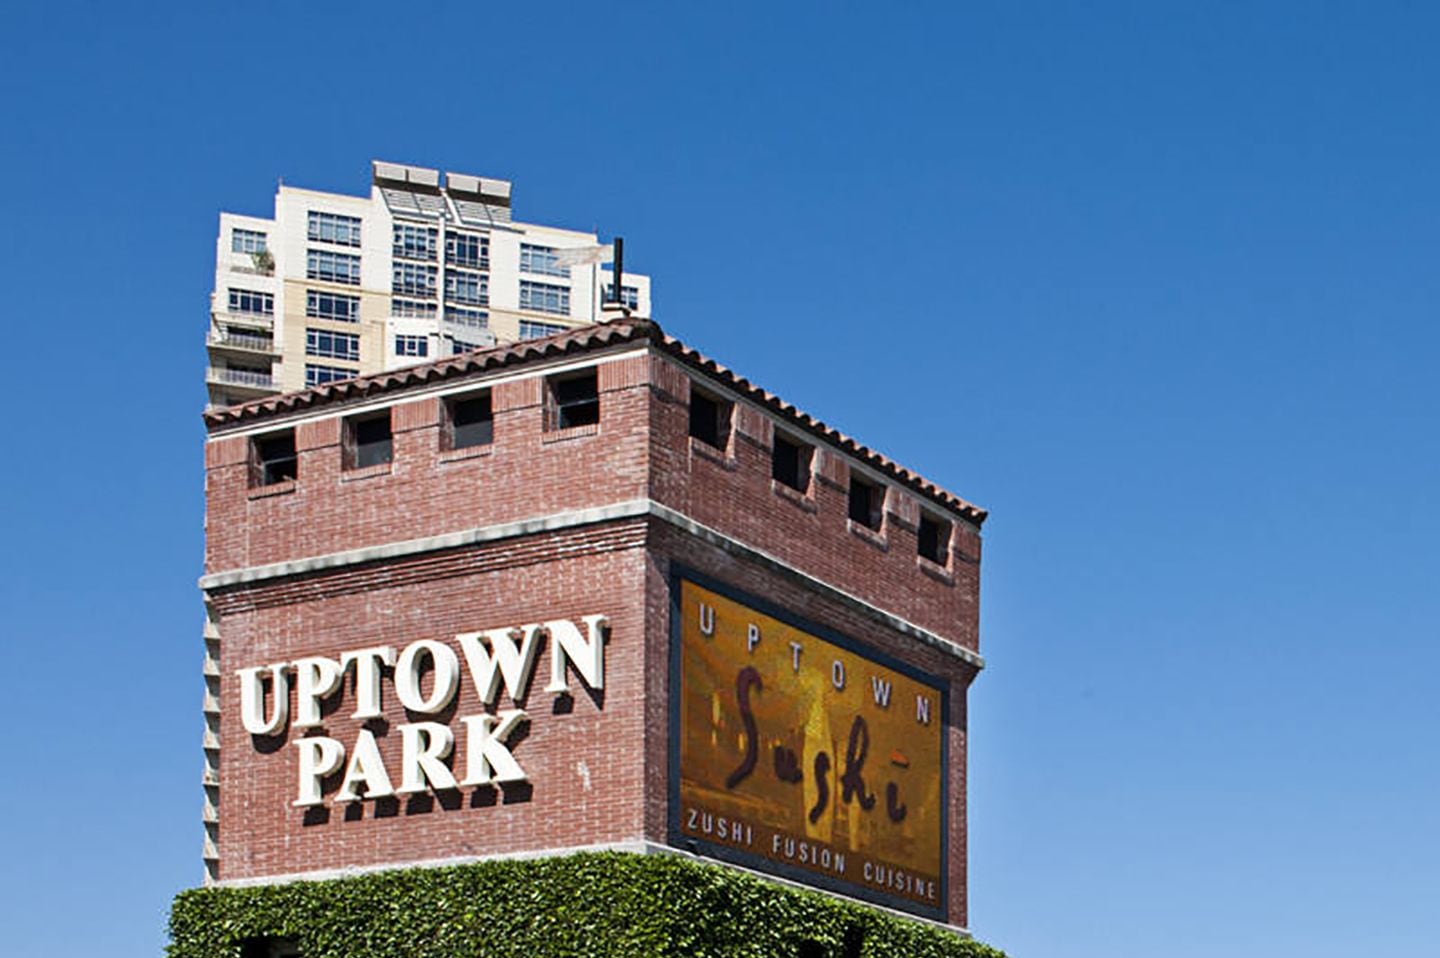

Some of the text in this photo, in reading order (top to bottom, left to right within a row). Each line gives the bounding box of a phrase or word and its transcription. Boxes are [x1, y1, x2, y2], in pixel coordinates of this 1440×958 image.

[235, 614, 608, 737] UPTOWN
[699, 602, 930, 724] UPTOWN
[292, 708, 528, 807] PARK
[725, 666, 909, 824] Sushi
[687, 808, 936, 899] ZUSHI FUSION CUISINE
